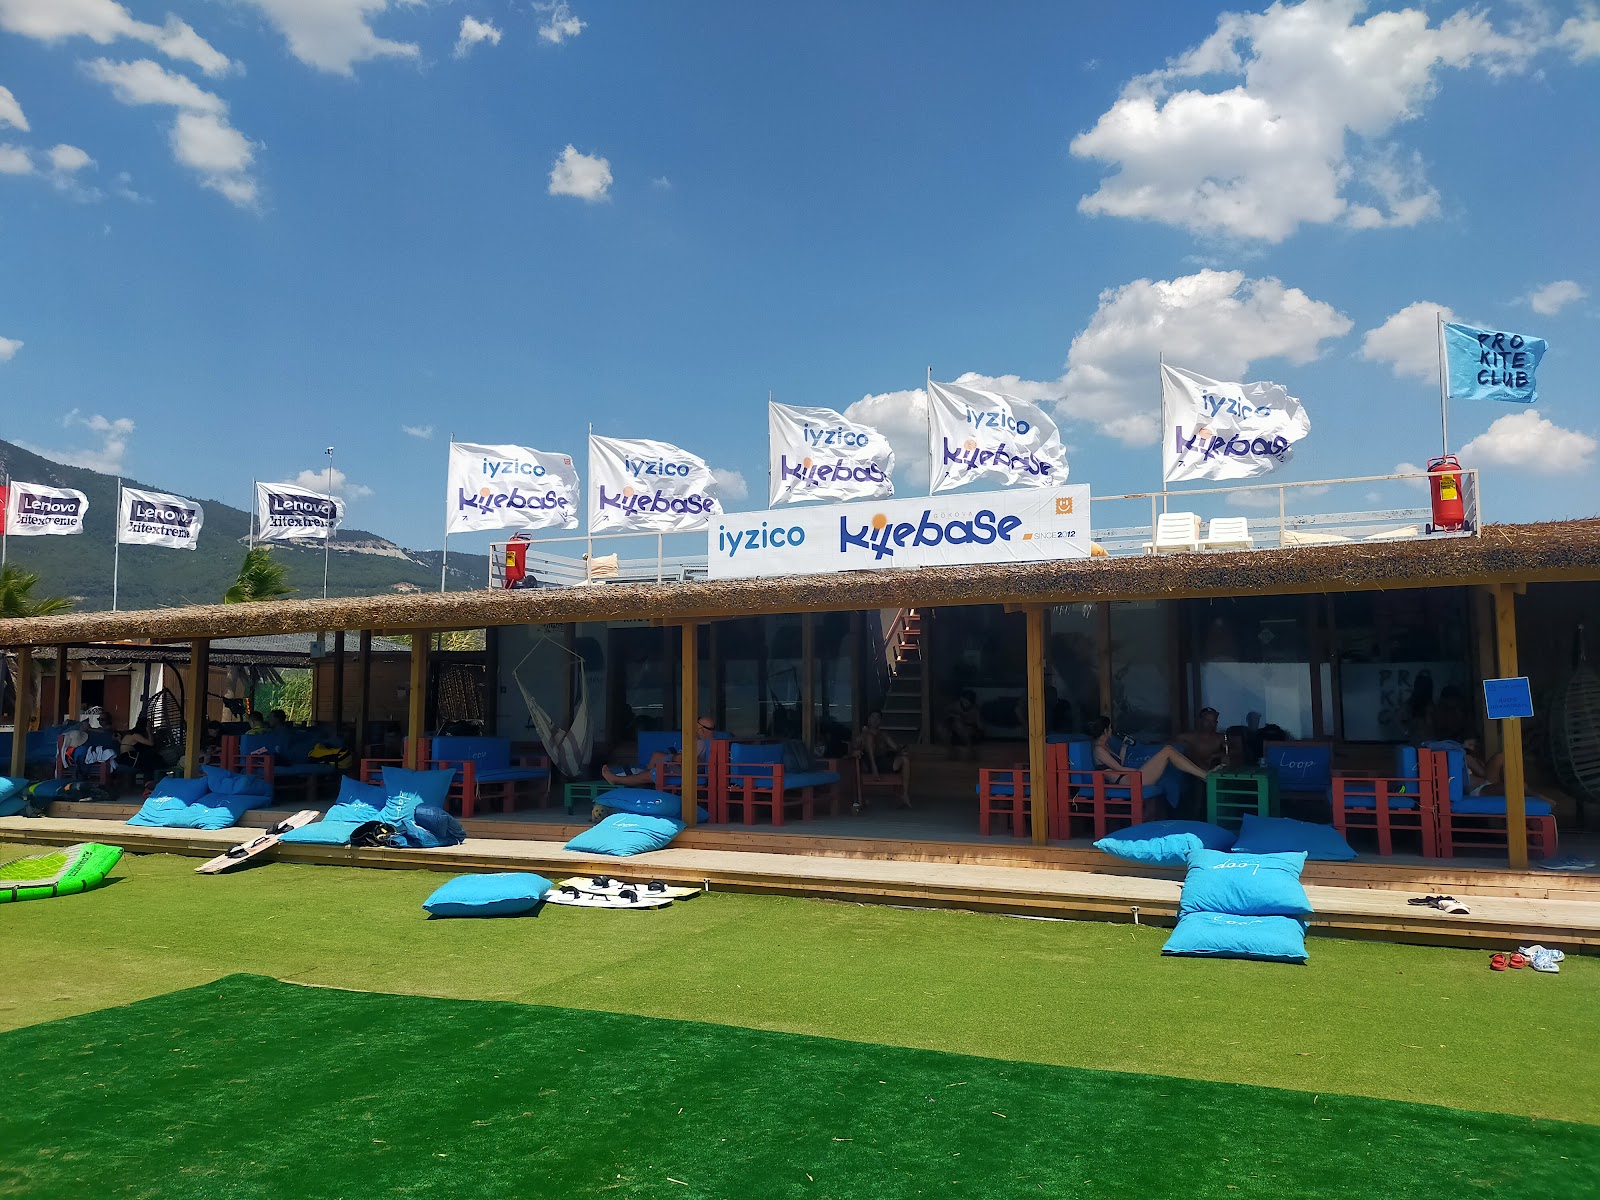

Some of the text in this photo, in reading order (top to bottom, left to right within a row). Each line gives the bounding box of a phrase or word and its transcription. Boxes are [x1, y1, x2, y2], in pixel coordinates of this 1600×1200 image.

[1477, 333, 1524, 351] PRO
[1479, 350, 1526, 369] KITE
[1477, 369, 1529, 388] CLUB
[965, 404, 1030, 435] iyzico
[803, 423, 869, 447] iyzico
[482, 457, 546, 478] iyzico
[624, 454, 690, 477] iyzico
[24, 497, 76, 513] Lenovo
[136, 504, 188, 522] Lenovo
[274, 498, 331, 515] Lenovo
[933, 511, 974, 519] GÖKOVA
[719, 521, 806, 558] iyzico
[1033, 530, 1076, 540] SINCE 2012
[1280, 751, 1314, 778] Loop
